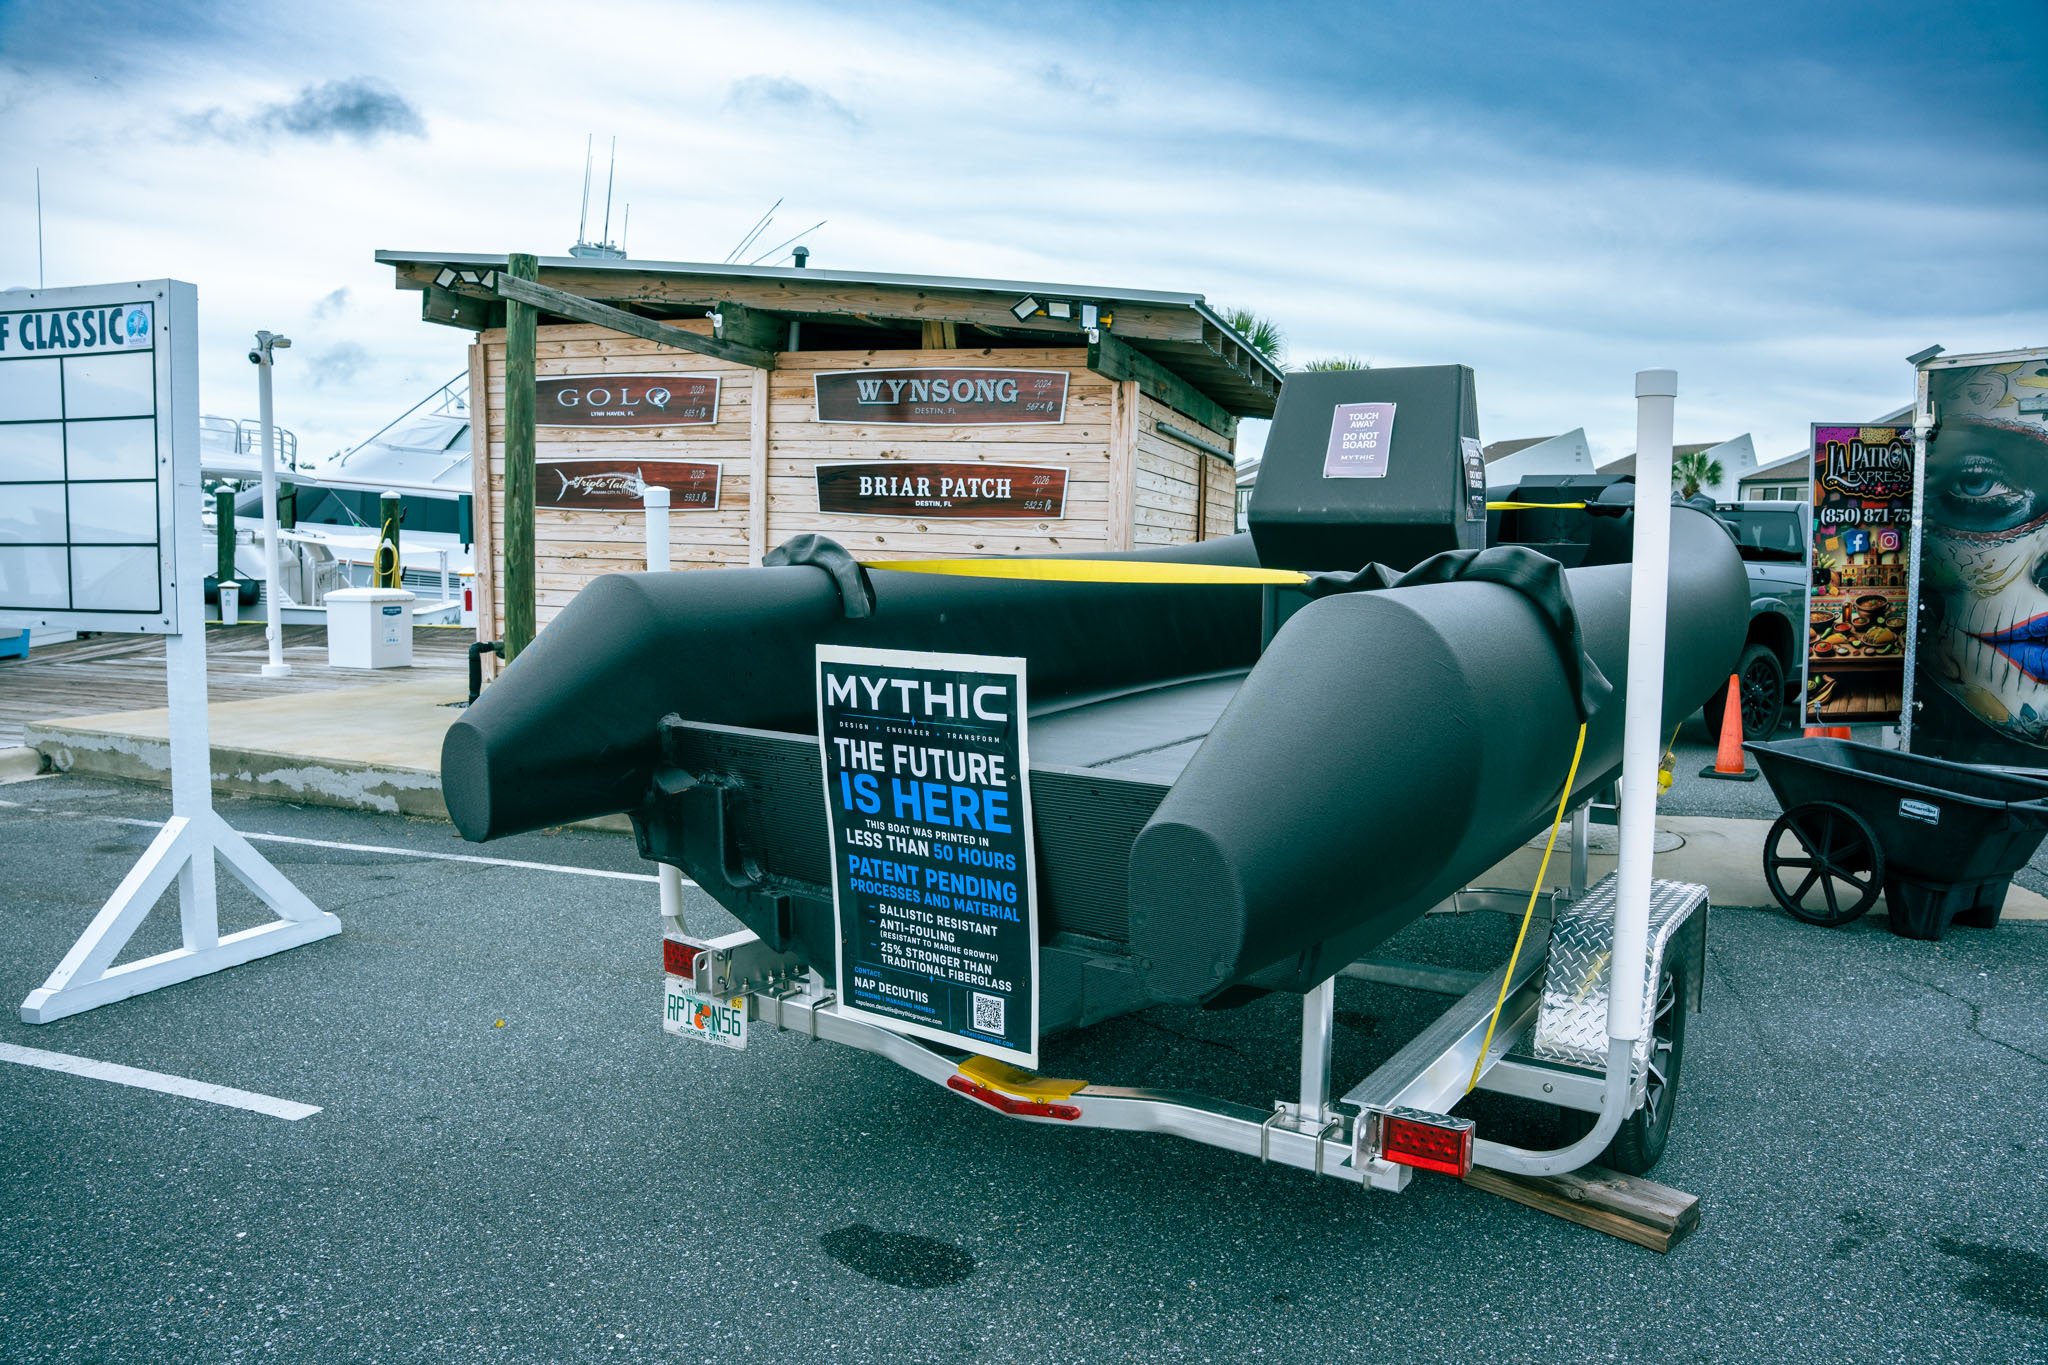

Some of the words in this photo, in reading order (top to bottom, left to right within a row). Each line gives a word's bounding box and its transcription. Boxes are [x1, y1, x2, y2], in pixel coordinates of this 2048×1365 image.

[20, 308, 124, 350] CLASSIC
[856, 379, 1020, 405] WYNSONG
[915, 407, 945, 415] DESTIN,
[1349, 412, 1379, 420] TOUCH
[1343, 432, 1357, 441] DO
[1359, 432, 1379, 440] NOT
[1350, 420, 1375, 428] AWAY
[1343, 440, 1377, 449] BOARD
[1852, 442, 1914, 472] PATRON
[574, 477, 607, 490] Triple
[859, 476, 932, 497] BRIAR
[940, 477, 1012, 499] PATCH
[1032, 475, 1050, 485] 2026
[1470, 479, 1482, 488] BOARD
[1848, 471, 1910, 484] EXPRESS
[915, 500, 943, 508] DESTIN,
[1821, 508, 1861, 525] (850)
[1863, 508, 1912, 522] 871-75
[827, 673, 1007, 722] MYTHIC
[839, 721, 869, 730] DESIGN
[886, 726, 930, 737] ENGINEER
[947, 732, 1000, 743] TRANSFORM
[834, 737, 885, 772] THE
[892, 744, 1007, 787] FUTURE
[840, 771, 881, 814] IS
[892, 777, 1012, 834] HERE
[865, 819, 885, 831] THIS
[887, 822, 910, 835] BOAT
[912, 827, 933, 838] WAS
[935, 831, 975, 845] PRINTED
[979, 836, 989, 847] IN
[846, 828, 882, 849] LESS
[886, 834, 929, 857] THAN
[933, 843, 953, 861] 50
[958, 847, 1016, 871] HOURS
[848, 854, 919, 885] PATENT
[925, 868, 1017, 903] PENDING
[850, 877, 921, 903] PROCESSES
[924, 892, 950, 909] AND
[953, 898, 1021, 922] MATERIAL
[879, 903, 934, 924] BALLISTIC
[937, 915, 998, 937] RESISTANT
[880, 918, 955, 943] ANTI-FOULING
[880, 930, 921, 946] (RESISTANT
[923, 938, 932, 948] TO
[933, 941, 961, 955] MARINE
[963, 948, 999, 963] GROWTH)
[881, 942, 903, 956] 25%
[905, 947, 960, 968] STRONGER
[963, 960, 992, 975] THAN
[854, 966, 883, 978] CONTACT:
[881, 954, 946, 978] TRADITIONAL
[948, 969, 1012, 992] FIBERGLASS
[854, 976, 876, 990] NAP
[878, 981, 929, 1004] DECIUTIIS
[854, 989, 881, 1001] FOUNDING
[886, 996, 912, 1008] MANAGING
[913, 1004, 935, 1014] MEMBER
[712, 1005, 741, 1037] N56
[680, 1026, 707, 1039] SUNSHINE
[709, 1033, 728, 1044] STATE
